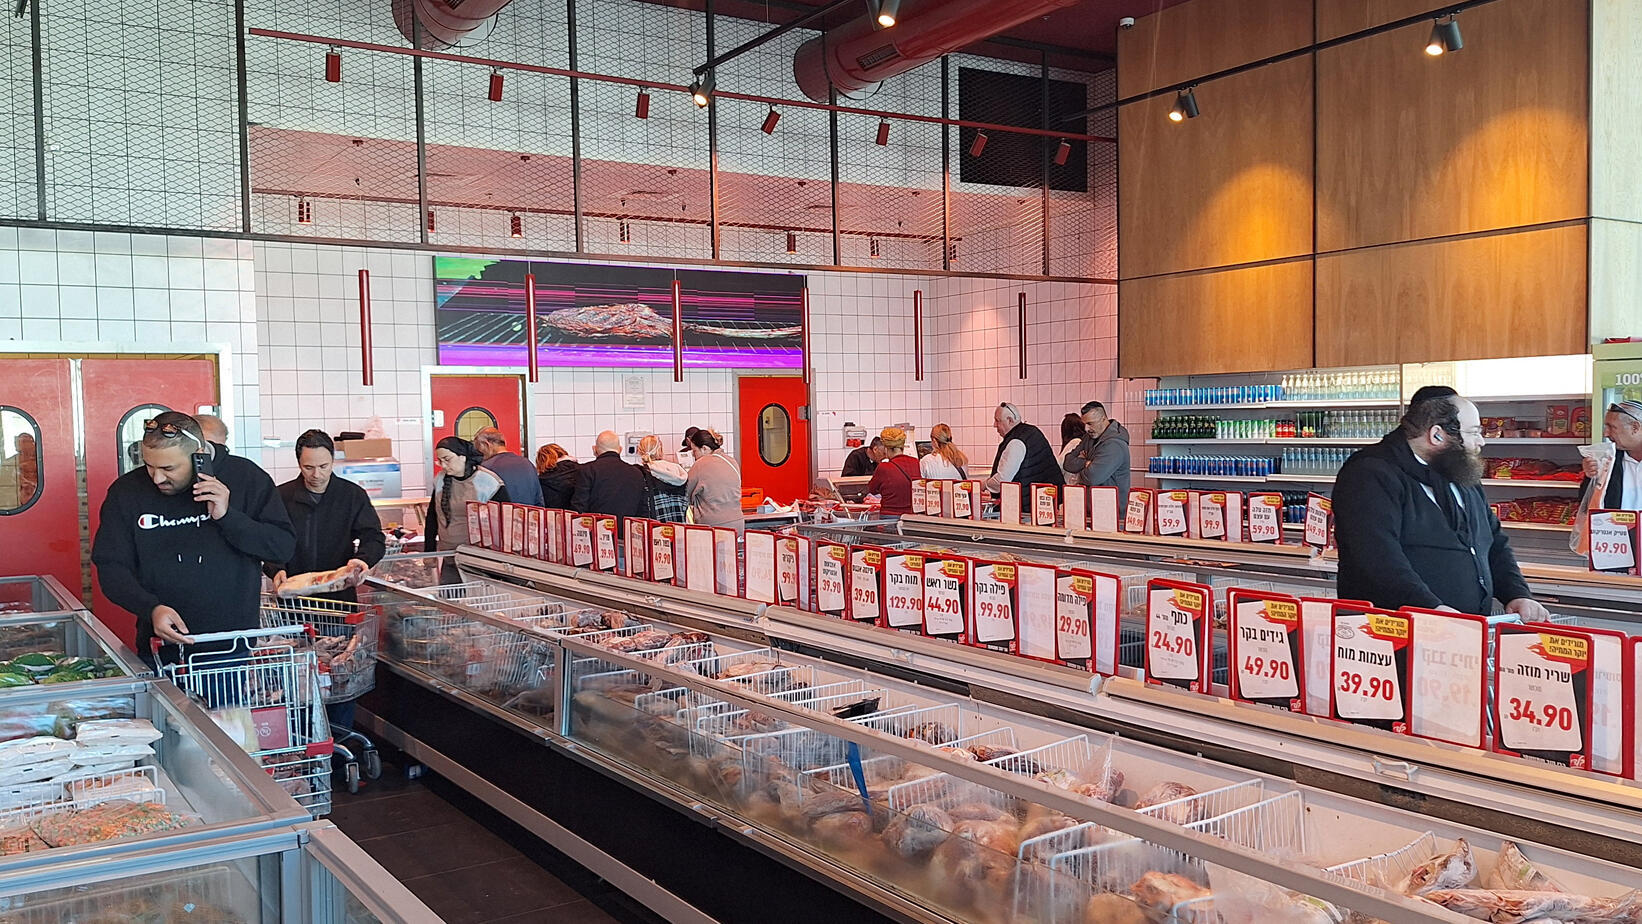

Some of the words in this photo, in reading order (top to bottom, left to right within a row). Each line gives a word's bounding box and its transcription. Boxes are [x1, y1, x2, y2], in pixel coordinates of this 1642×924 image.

[1616, 373, 1642, 386] 100
[138, 513, 211, 530] Champ
[1252, 525, 1275, 535] 59.90
[1595, 541, 1628, 554] 49.90
[822, 579, 841, 594] 39.90
[889, 573, 903, 585] בקר
[906, 575, 918, 585] מוח
[926, 577, 941, 589] ראש
[943, 579, 957, 591] בשר
[854, 588, 876, 604] 39.90
[975, 582, 988, 595] בקר
[990, 583, 1006, 595] פילה
[889, 595, 922, 611] 129.90
[927, 596, 959, 614] 44.90
[980, 601, 1010, 620] 99.90
[1171, 610, 1188, 625] כתף
[1060, 615, 1088, 637] 29.90
[1240, 626, 1258, 641] בקר
[1153, 630, 1193, 657] 24.90
[1260, 629, 1284, 644] גידים
[1337, 646, 1355, 661] מוח
[1358, 650, 1392, 667] עצמות
[1244, 655, 1290, 681] 49.90
[1517, 664, 1541, 679] מוזה
[1545, 668, 1570, 683] שריר
[1340, 671, 1394, 701] 39.90
[1510, 697, 1573, 731] 34.90
